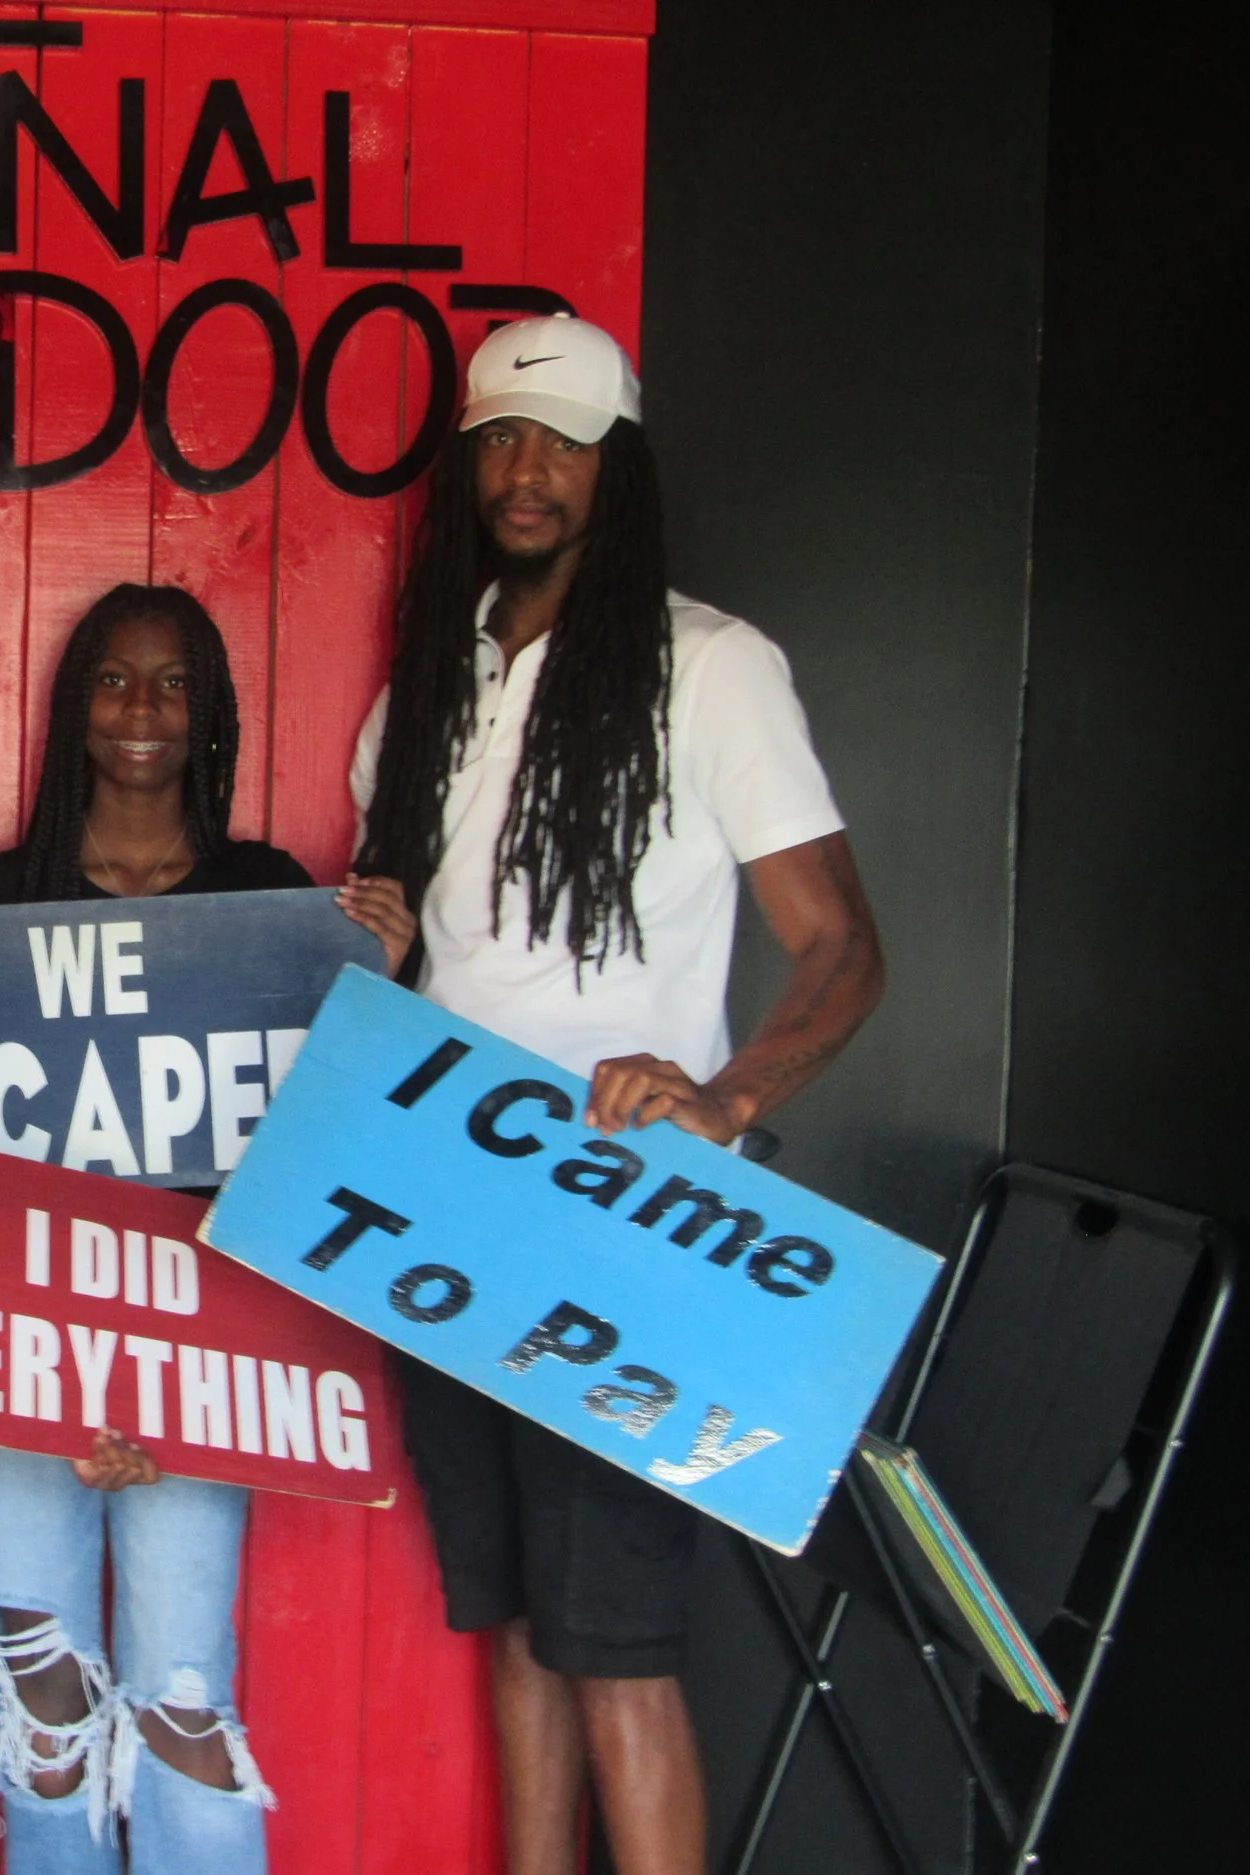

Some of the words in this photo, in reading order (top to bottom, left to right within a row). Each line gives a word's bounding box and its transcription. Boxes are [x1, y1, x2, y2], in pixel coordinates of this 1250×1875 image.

[27, 921, 149, 1019] WE
[386, 1037, 473, 1110] I
[465, 1078, 837, 1298] Came
[25, 1207, 50, 1288] I
[70, 1217, 200, 1317] DID
[300, 1186, 473, 1325] To
[496, 1299, 784, 1486] Pay
